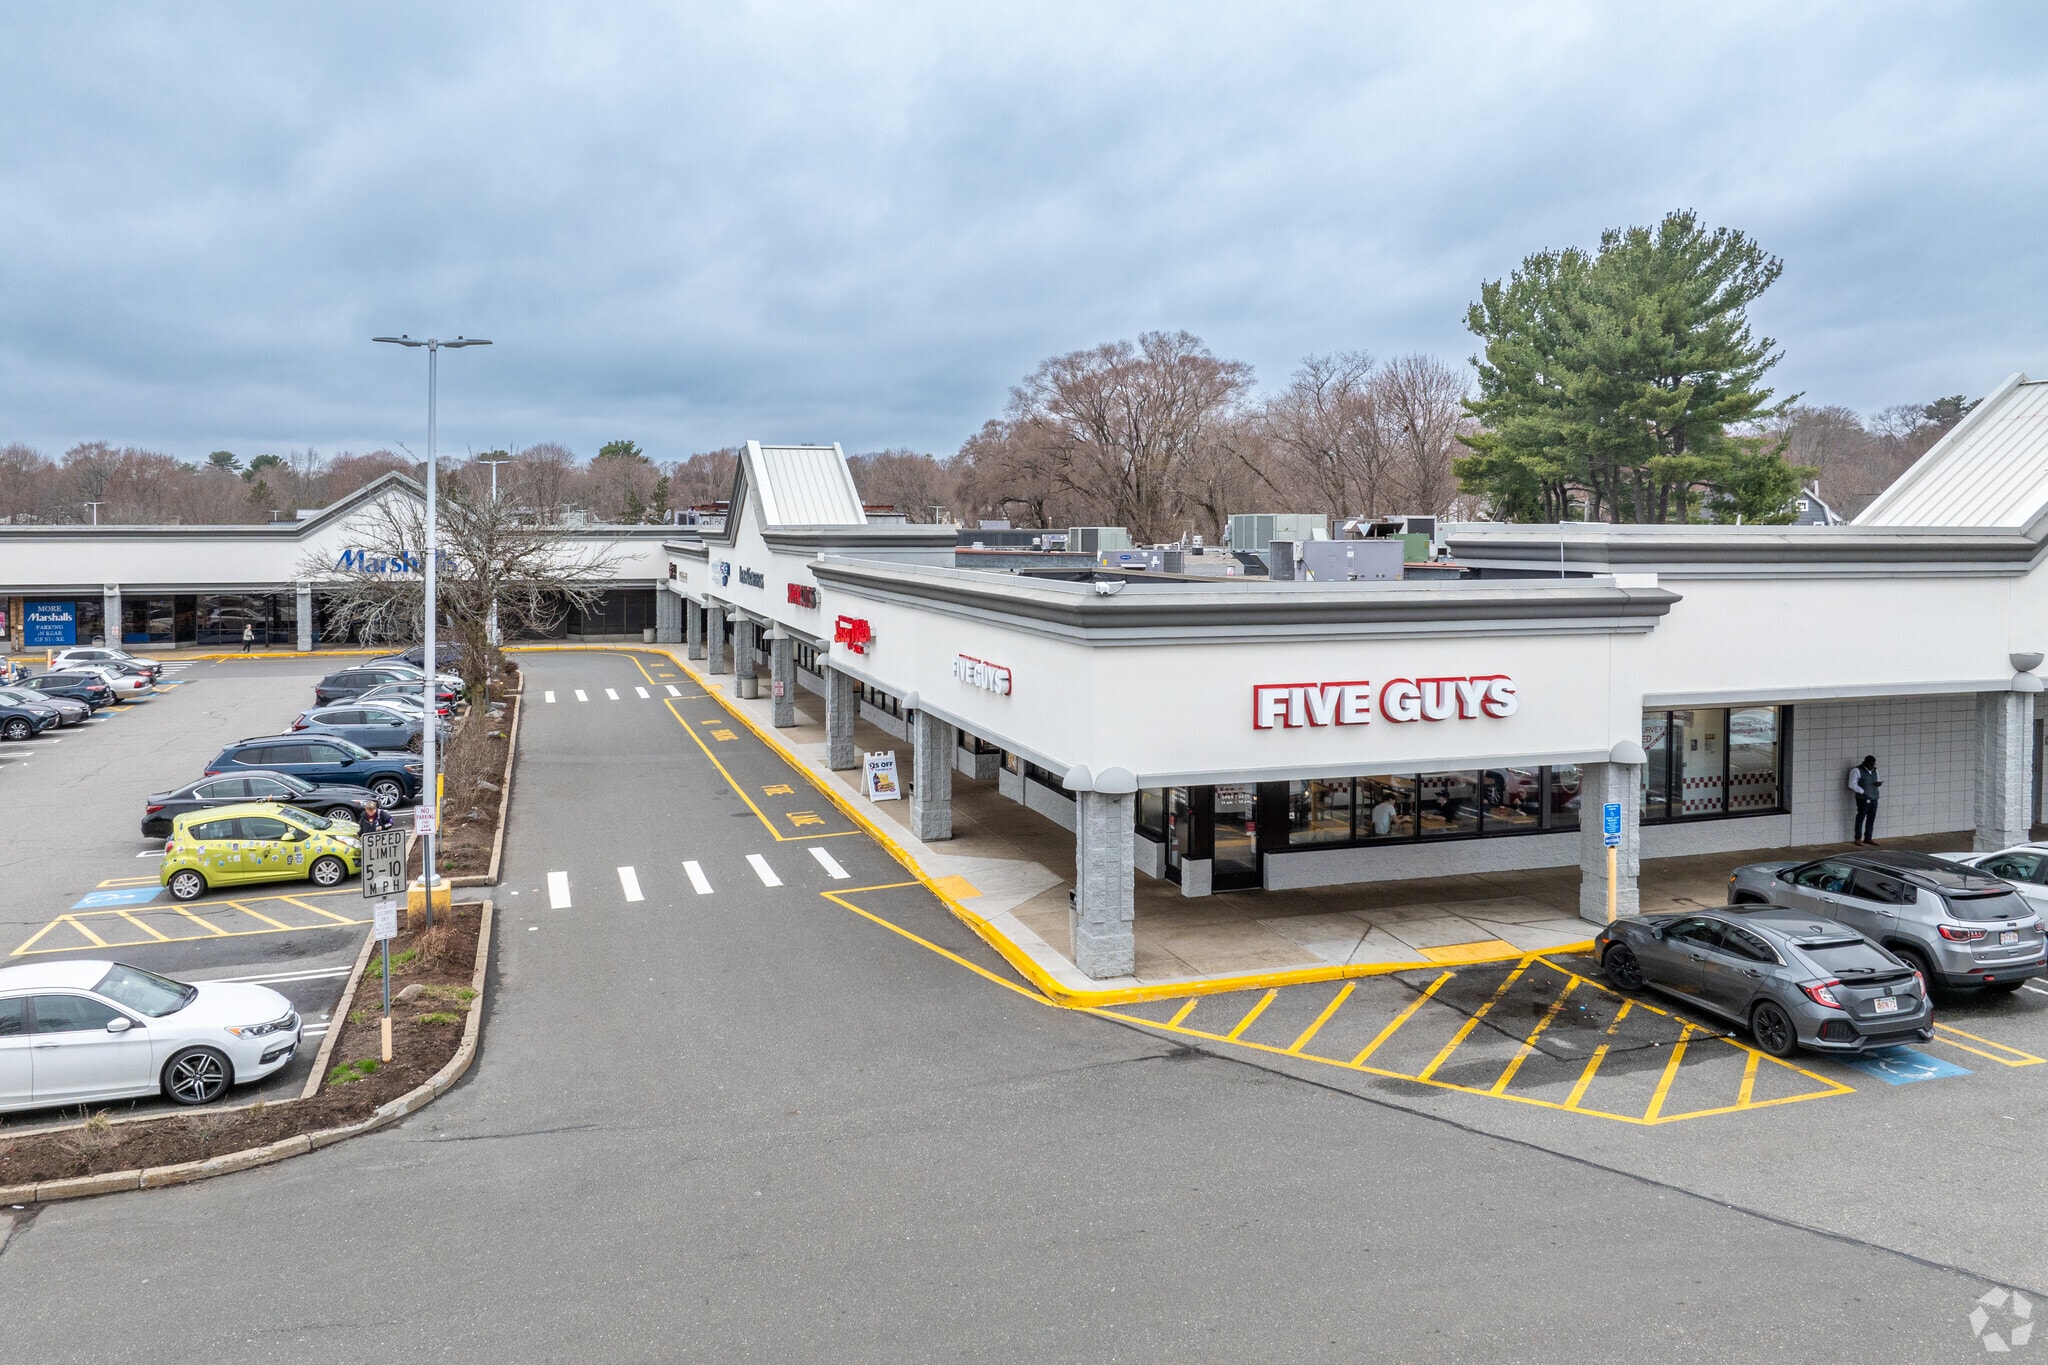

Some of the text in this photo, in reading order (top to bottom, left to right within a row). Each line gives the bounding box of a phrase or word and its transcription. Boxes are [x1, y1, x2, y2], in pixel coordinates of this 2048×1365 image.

[333, 549, 458, 573] Marshlls
[27, 612, 73, 622] Marshalls
[953, 654, 1012, 696] FIVE GUYS
[1253, 674, 1518, 730] FIVE GUYS
[367, 832, 401, 848] SPEED
[369, 845, 398, 861] LIMIT
